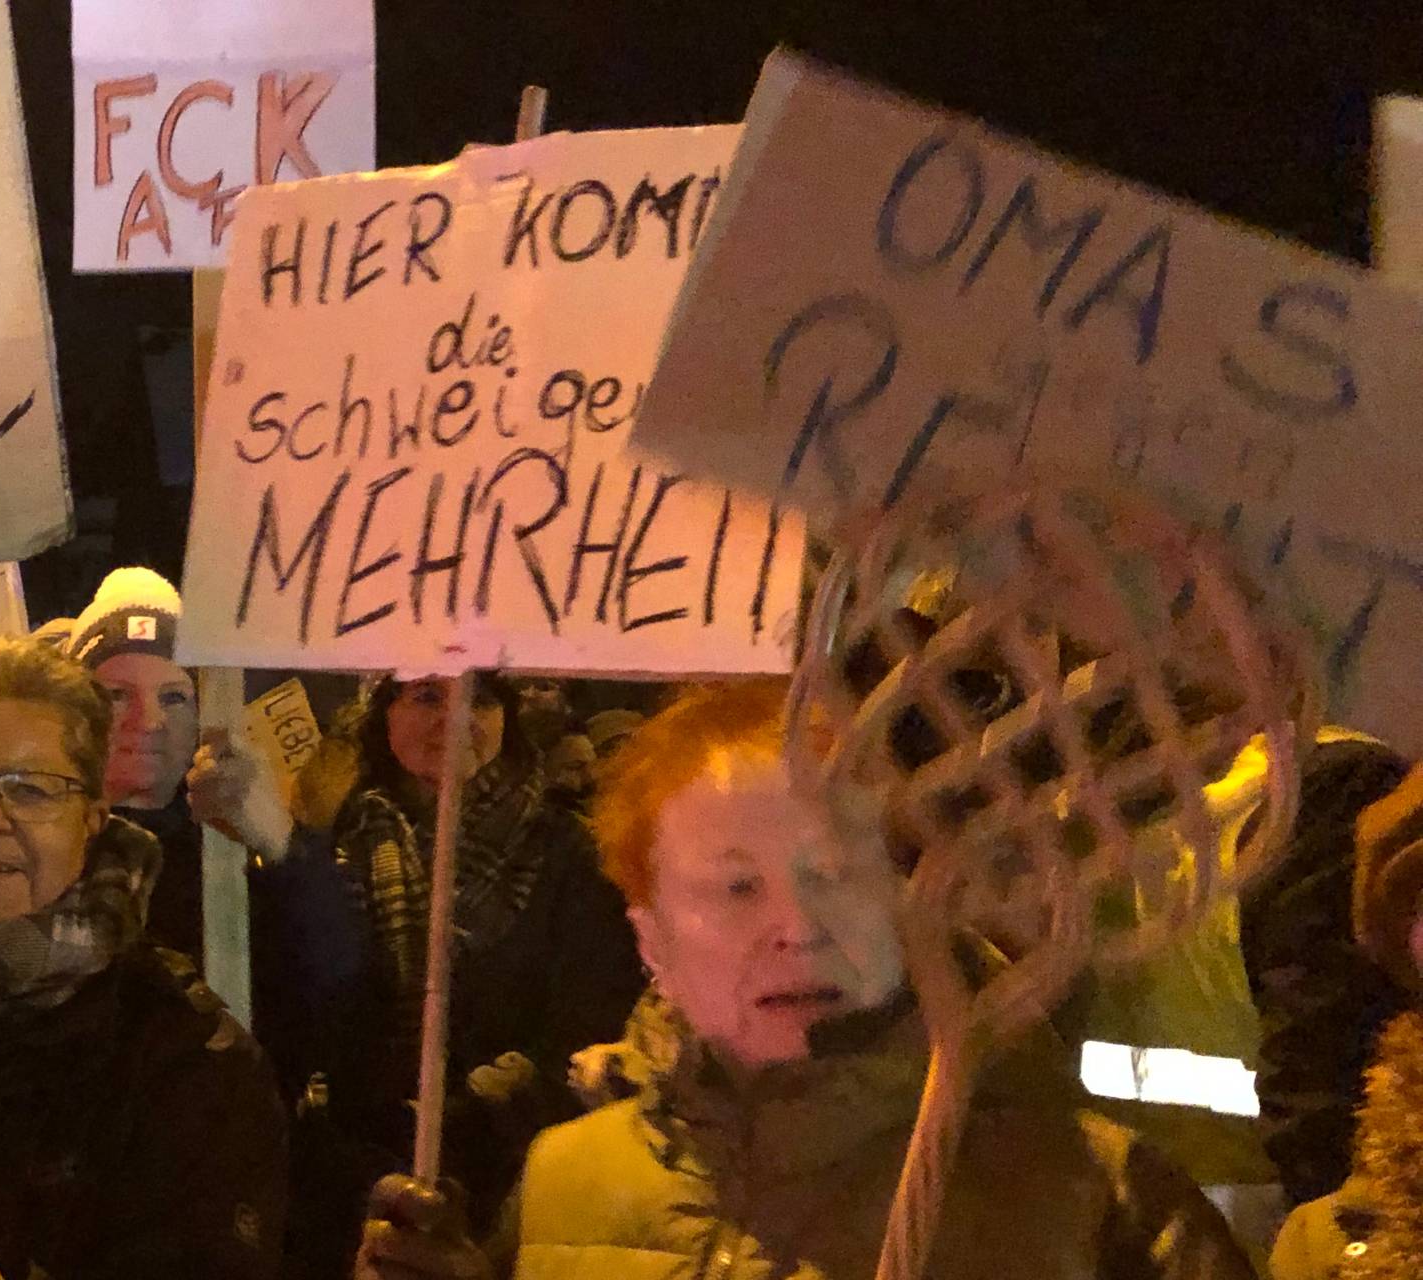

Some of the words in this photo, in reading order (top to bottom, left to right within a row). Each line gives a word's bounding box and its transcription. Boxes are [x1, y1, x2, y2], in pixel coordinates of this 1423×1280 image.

[94, 68, 341, 199] FCK
[117, 169, 248, 261] AF
[260, 190, 455, 307] HIER
[427, 291, 515, 374] die
